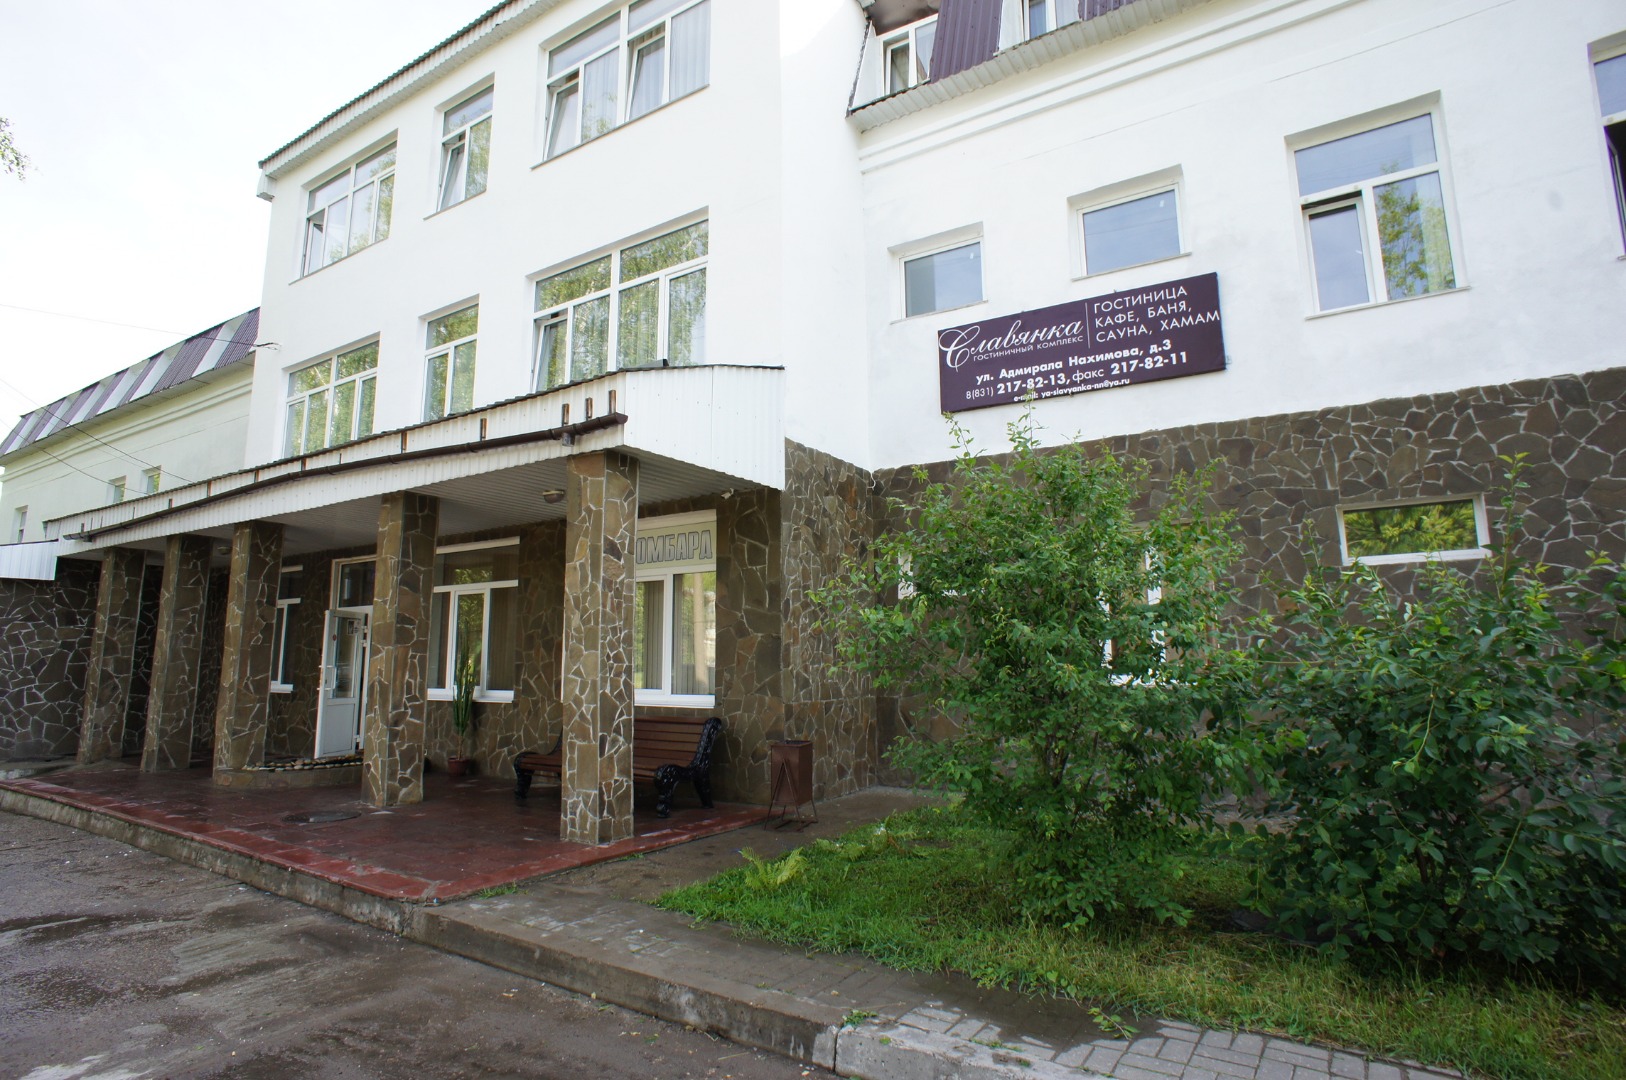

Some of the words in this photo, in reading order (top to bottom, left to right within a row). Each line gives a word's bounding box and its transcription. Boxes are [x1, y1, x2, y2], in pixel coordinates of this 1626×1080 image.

[1094, 286, 1188, 314] ГОСТИНИЦА
[1096, 312, 1140, 329] КАФЕ,
[1147, 300, 1191, 319] БАНЯ,
[1096, 325, 1152, 343] САУНА,
[1161, 310, 1220, 331] ХАМАМ
[938, 320, 1084, 372] Славянка
[973, 344, 1034, 362] ГОСТИНИЧНЫЙ
[1037, 335, 1084, 350] КОМПЛЕКС
[976, 375, 994, 385] ул.
[999, 361, 1063, 380] Адмирала
[1069, 347, 1142, 367] Нахимова,
[1150, 340, 1171, 355] д.3
[965, 387, 994, 400] 8(831)
[997, 374, 1070, 395] 217-82-13,
[1072, 368, 1105, 384] факс
[1111, 352, 1187, 375] 217-82-11
[1041, 379, 1130, 398] ya-slavyanka-nn@ya.ru
[636, 530, 713, 564] ОМБАРД
